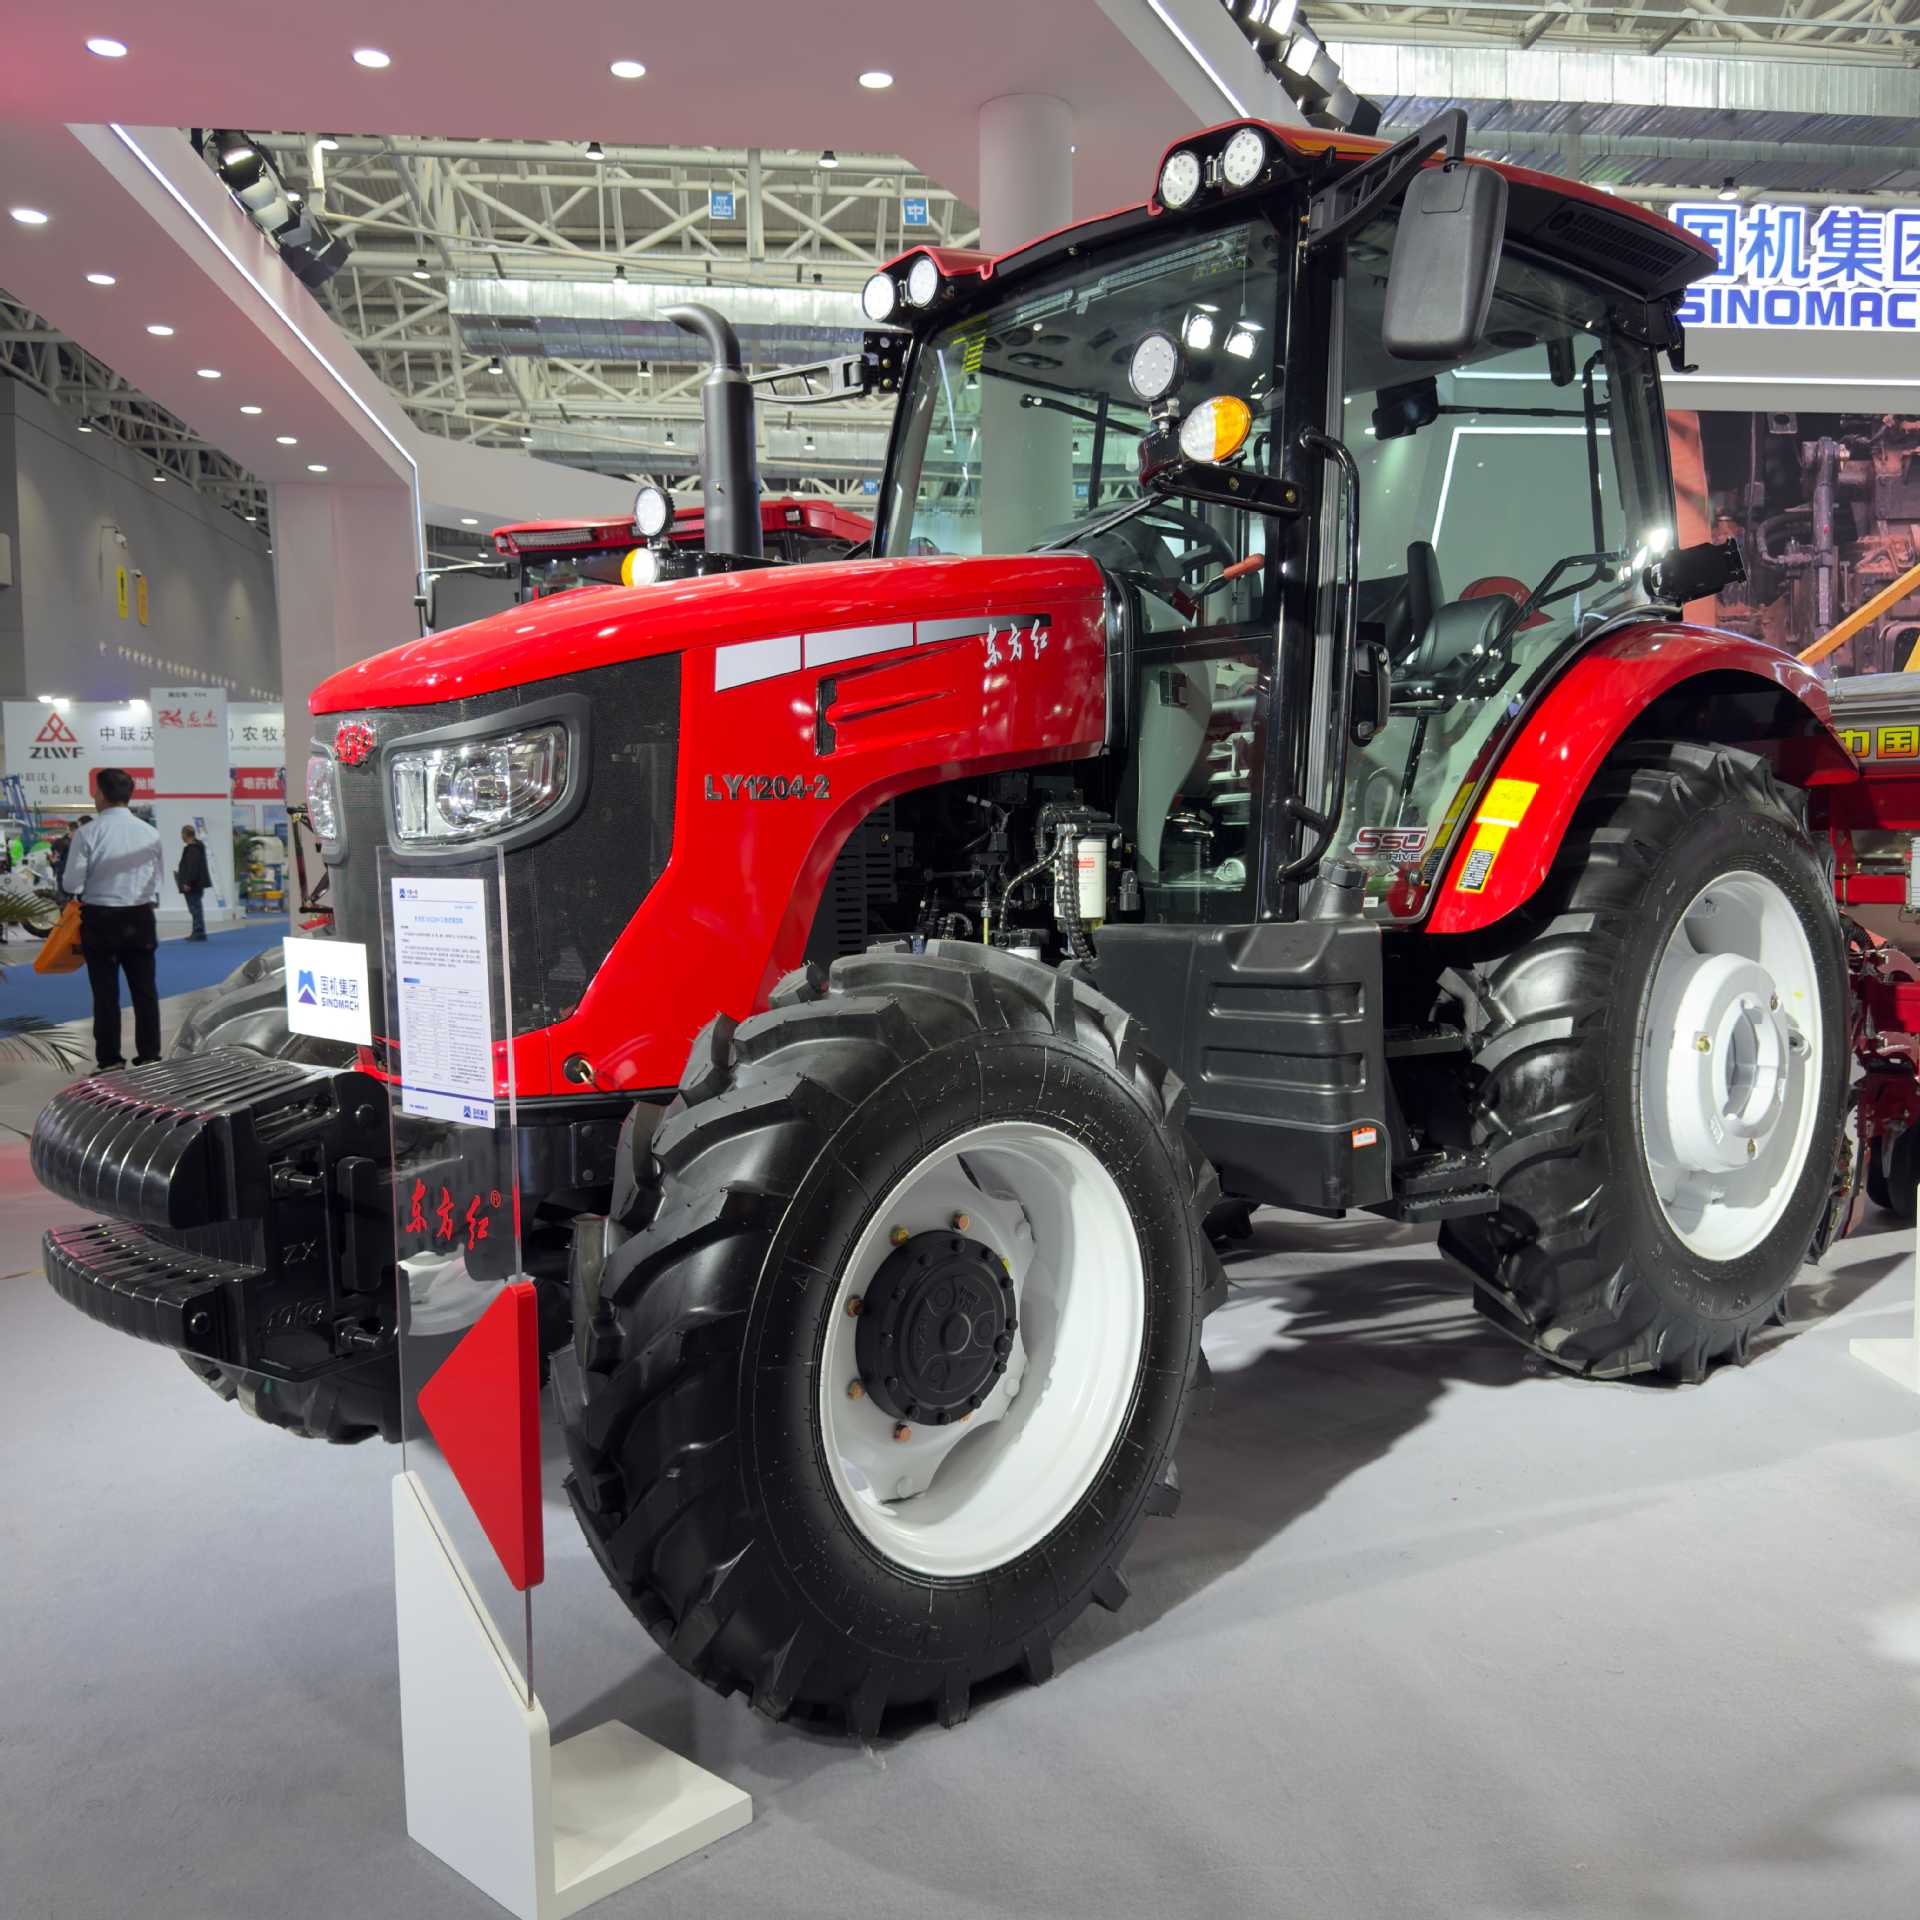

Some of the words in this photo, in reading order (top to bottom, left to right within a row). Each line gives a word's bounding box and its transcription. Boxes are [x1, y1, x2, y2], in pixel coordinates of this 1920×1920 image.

[983, 618, 1049, 669] 东方红
[704, 774, 831, 801] LY1204-2
[1354, 829, 1428, 856] SSU
[1378, 852, 1421, 863] DRIVE
[321, 996, 360, 1012] SINOMACH
